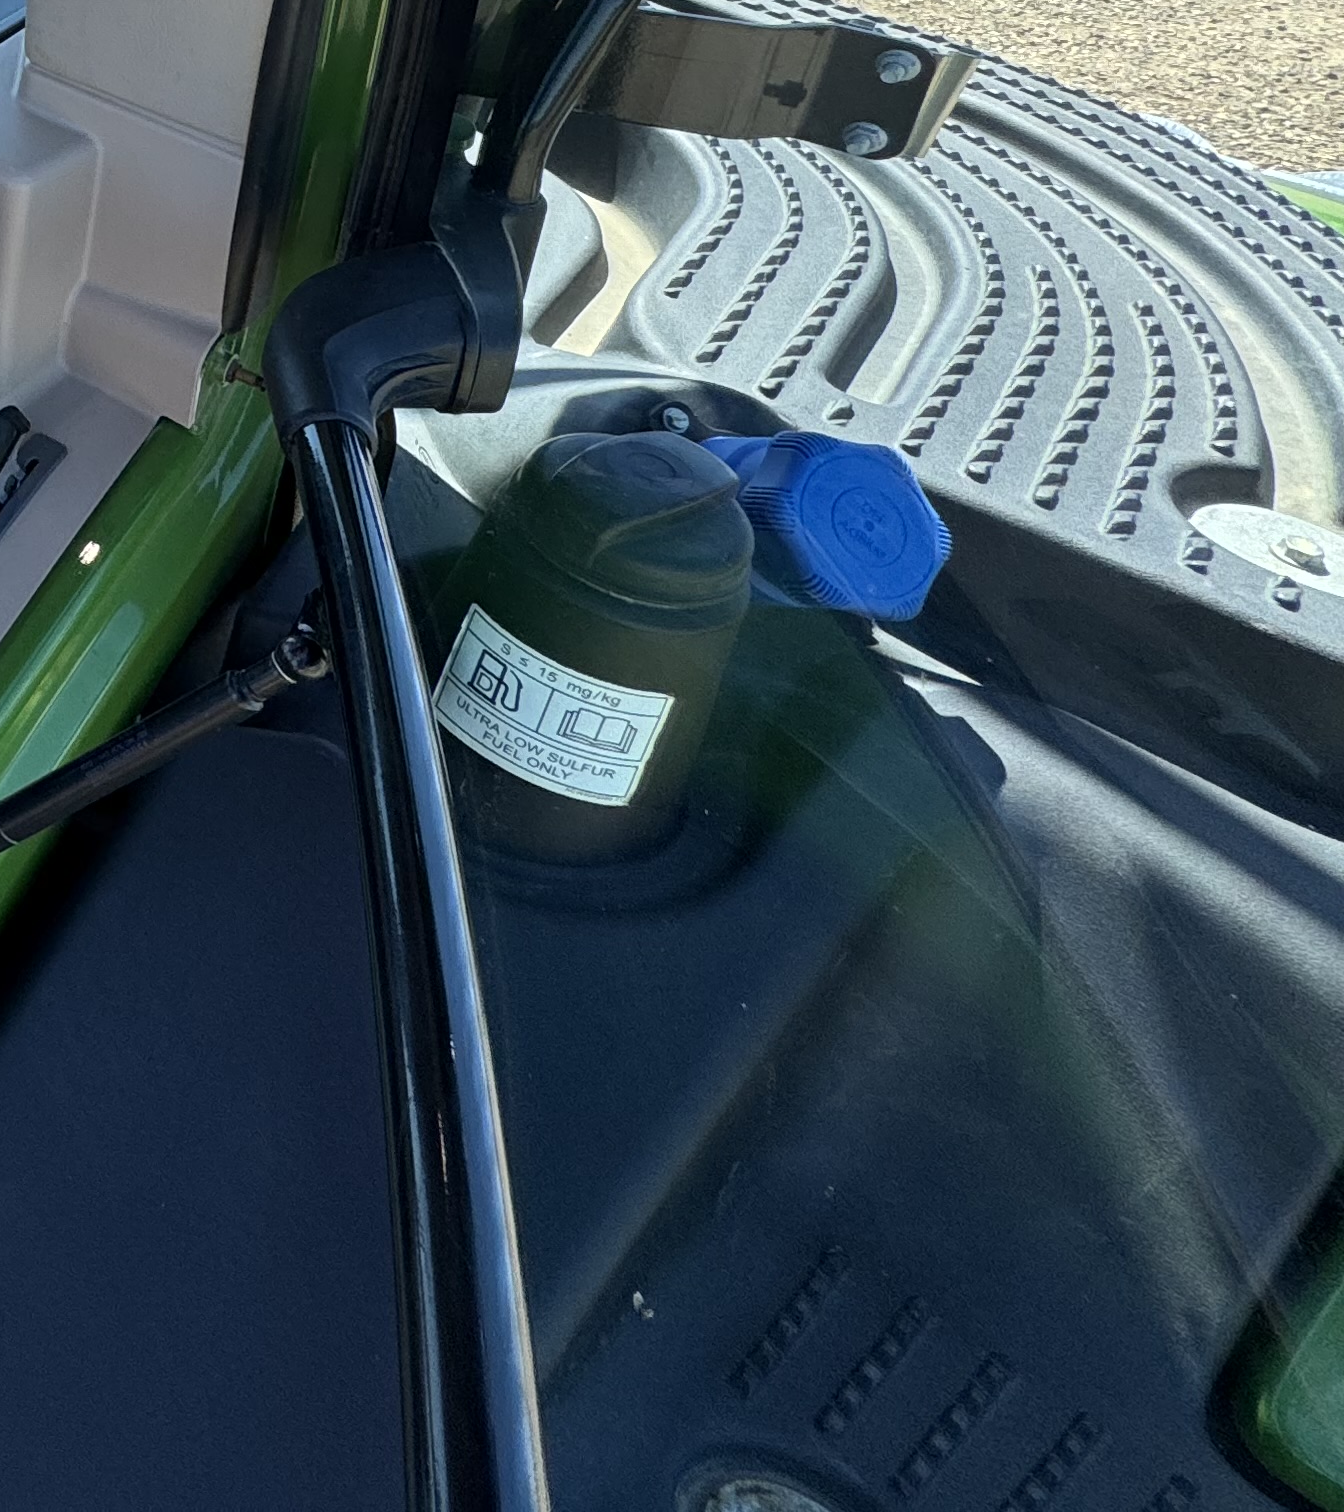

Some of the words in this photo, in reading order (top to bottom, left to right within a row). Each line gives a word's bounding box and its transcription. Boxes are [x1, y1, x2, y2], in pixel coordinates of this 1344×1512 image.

[500, 643, 512, 656] S
[539, 667, 558, 683] 15
[567, 681, 622, 708] mg/kg
[456, 696, 501, 732] ULTRA
[505, 728, 545, 754] LOW
[547, 751, 617, 779] SULFUR
[482, 731, 522, 762] FUEL
[526, 757, 573, 780] ONLY
